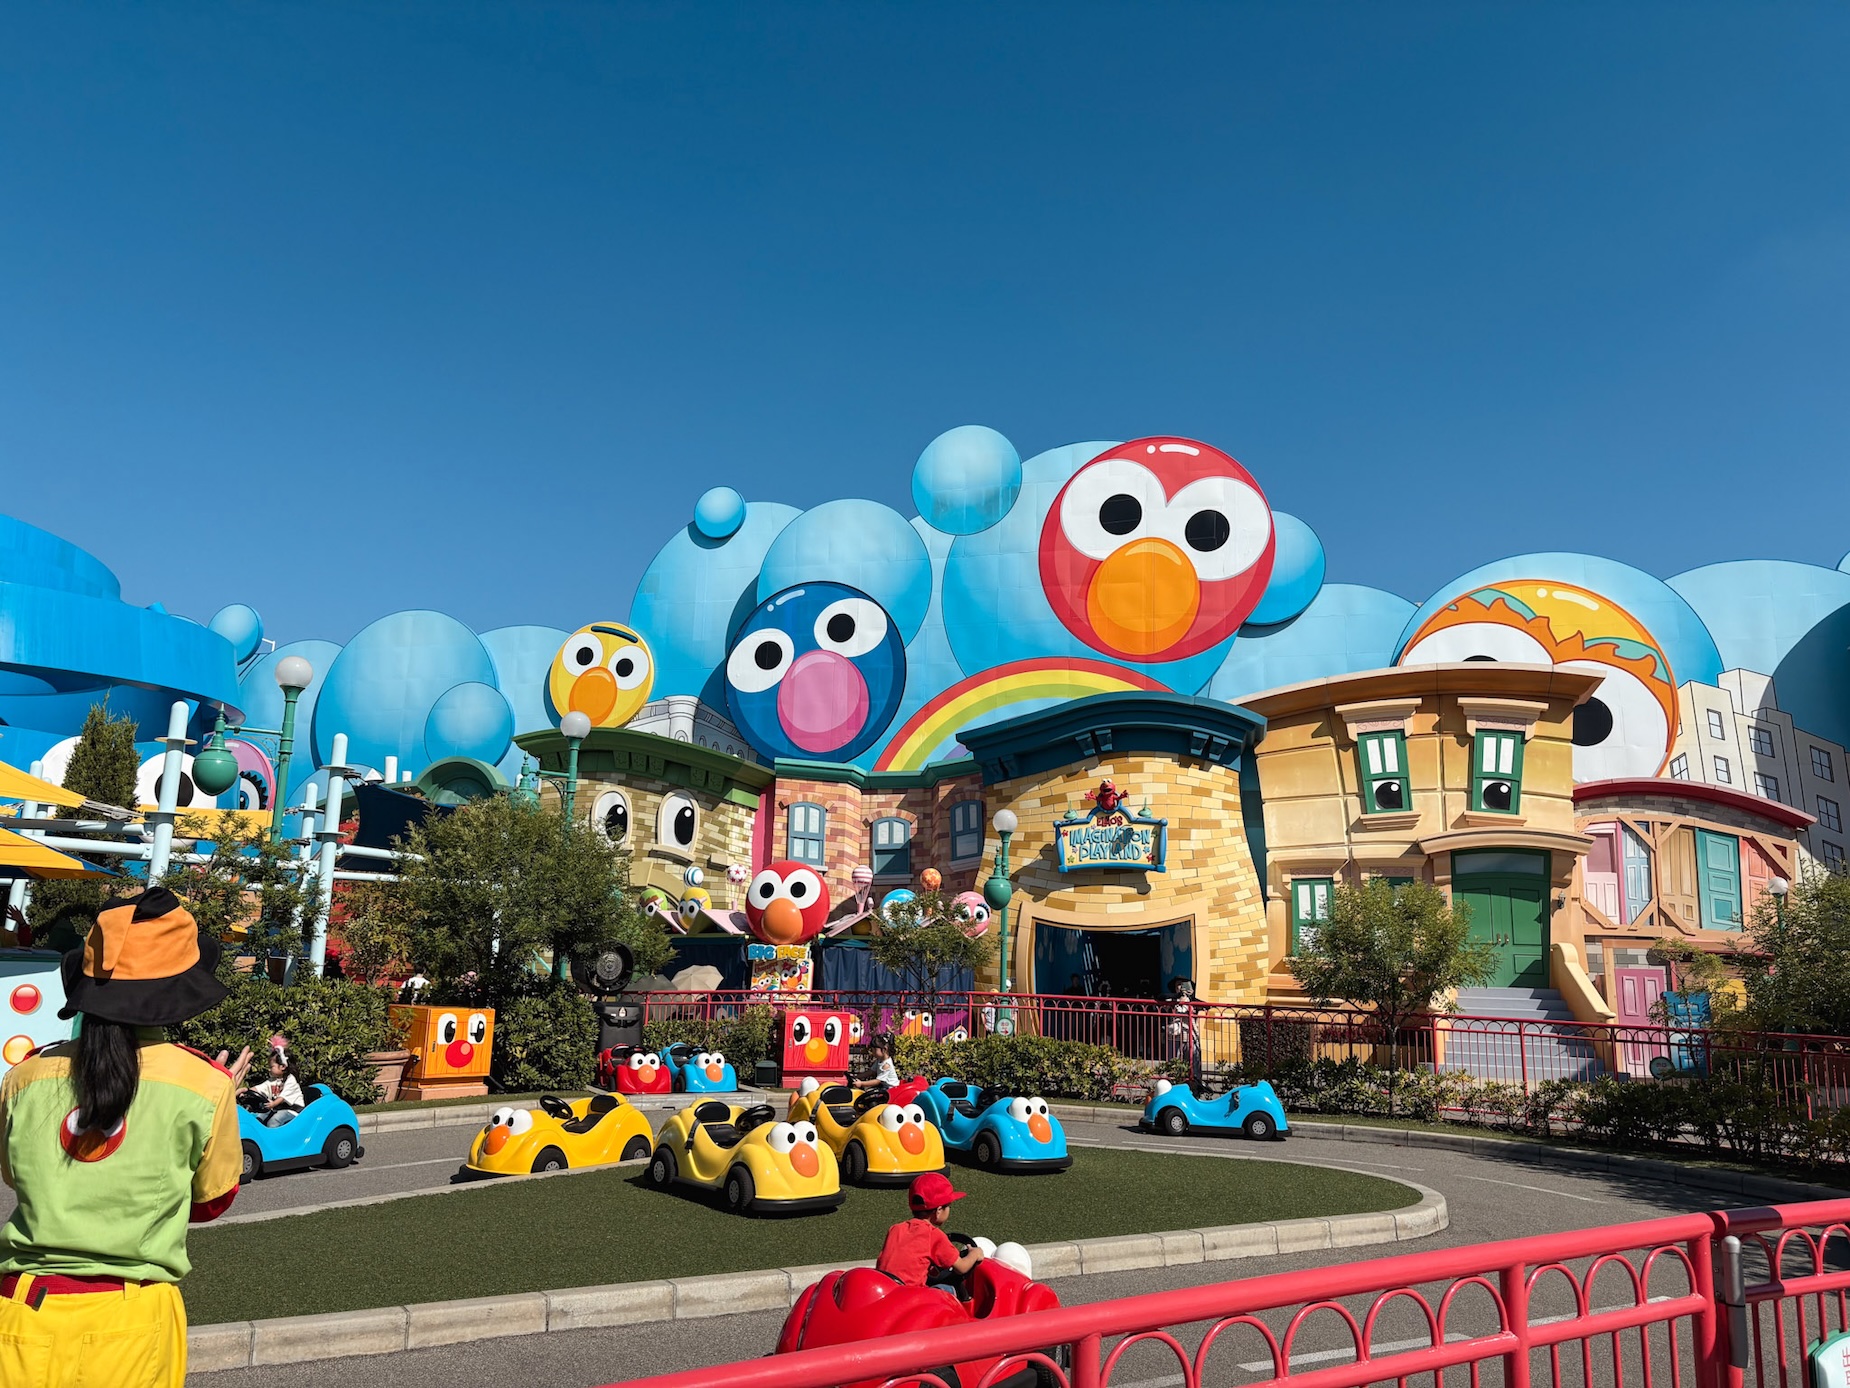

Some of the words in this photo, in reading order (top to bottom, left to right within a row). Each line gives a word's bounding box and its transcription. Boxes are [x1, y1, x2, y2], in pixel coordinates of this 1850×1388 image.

[1079, 843, 1142, 861] PLAYLAND
[748, 944, 775, 959] BIG
[777, 946, 807, 959] FACE
